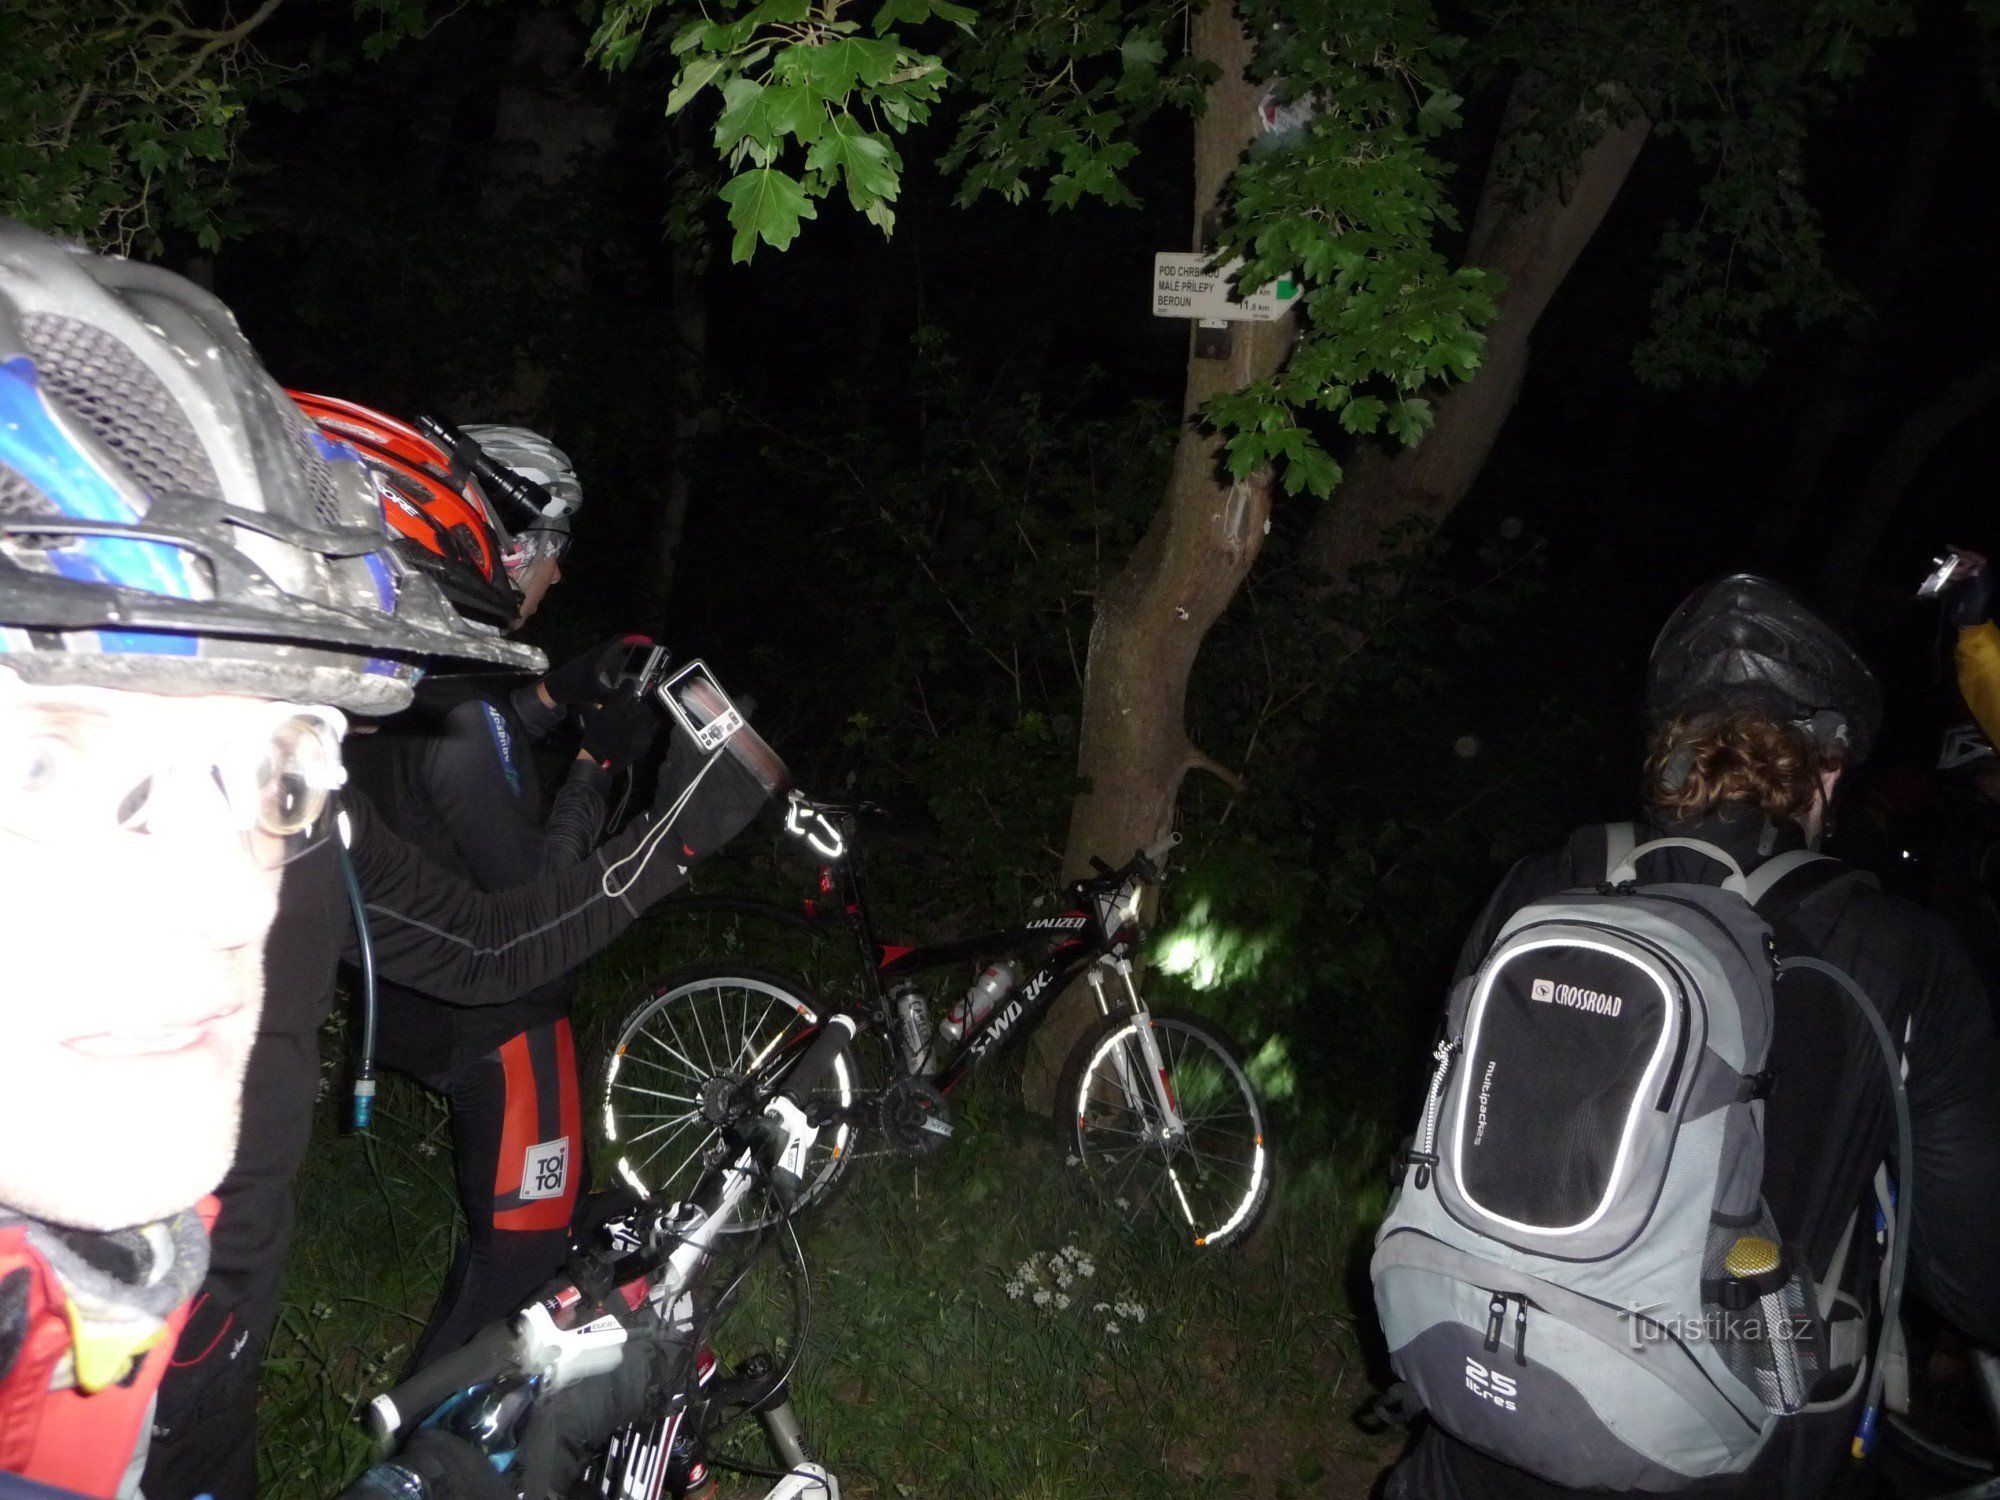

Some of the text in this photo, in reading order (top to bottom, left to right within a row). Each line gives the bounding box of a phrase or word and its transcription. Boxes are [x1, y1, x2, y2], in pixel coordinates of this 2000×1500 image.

[1159, 266, 1176, 276] POD
[1157, 295, 1192, 307] BEROUN
[1555, 983, 1622, 1017] CROSSROAD
[537, 1154, 564, 1175] TOI
[535, 1171, 562, 1191] TOI
[1465, 1356, 1517, 1396] 25
[1465, 1376, 1517, 1411] litres
